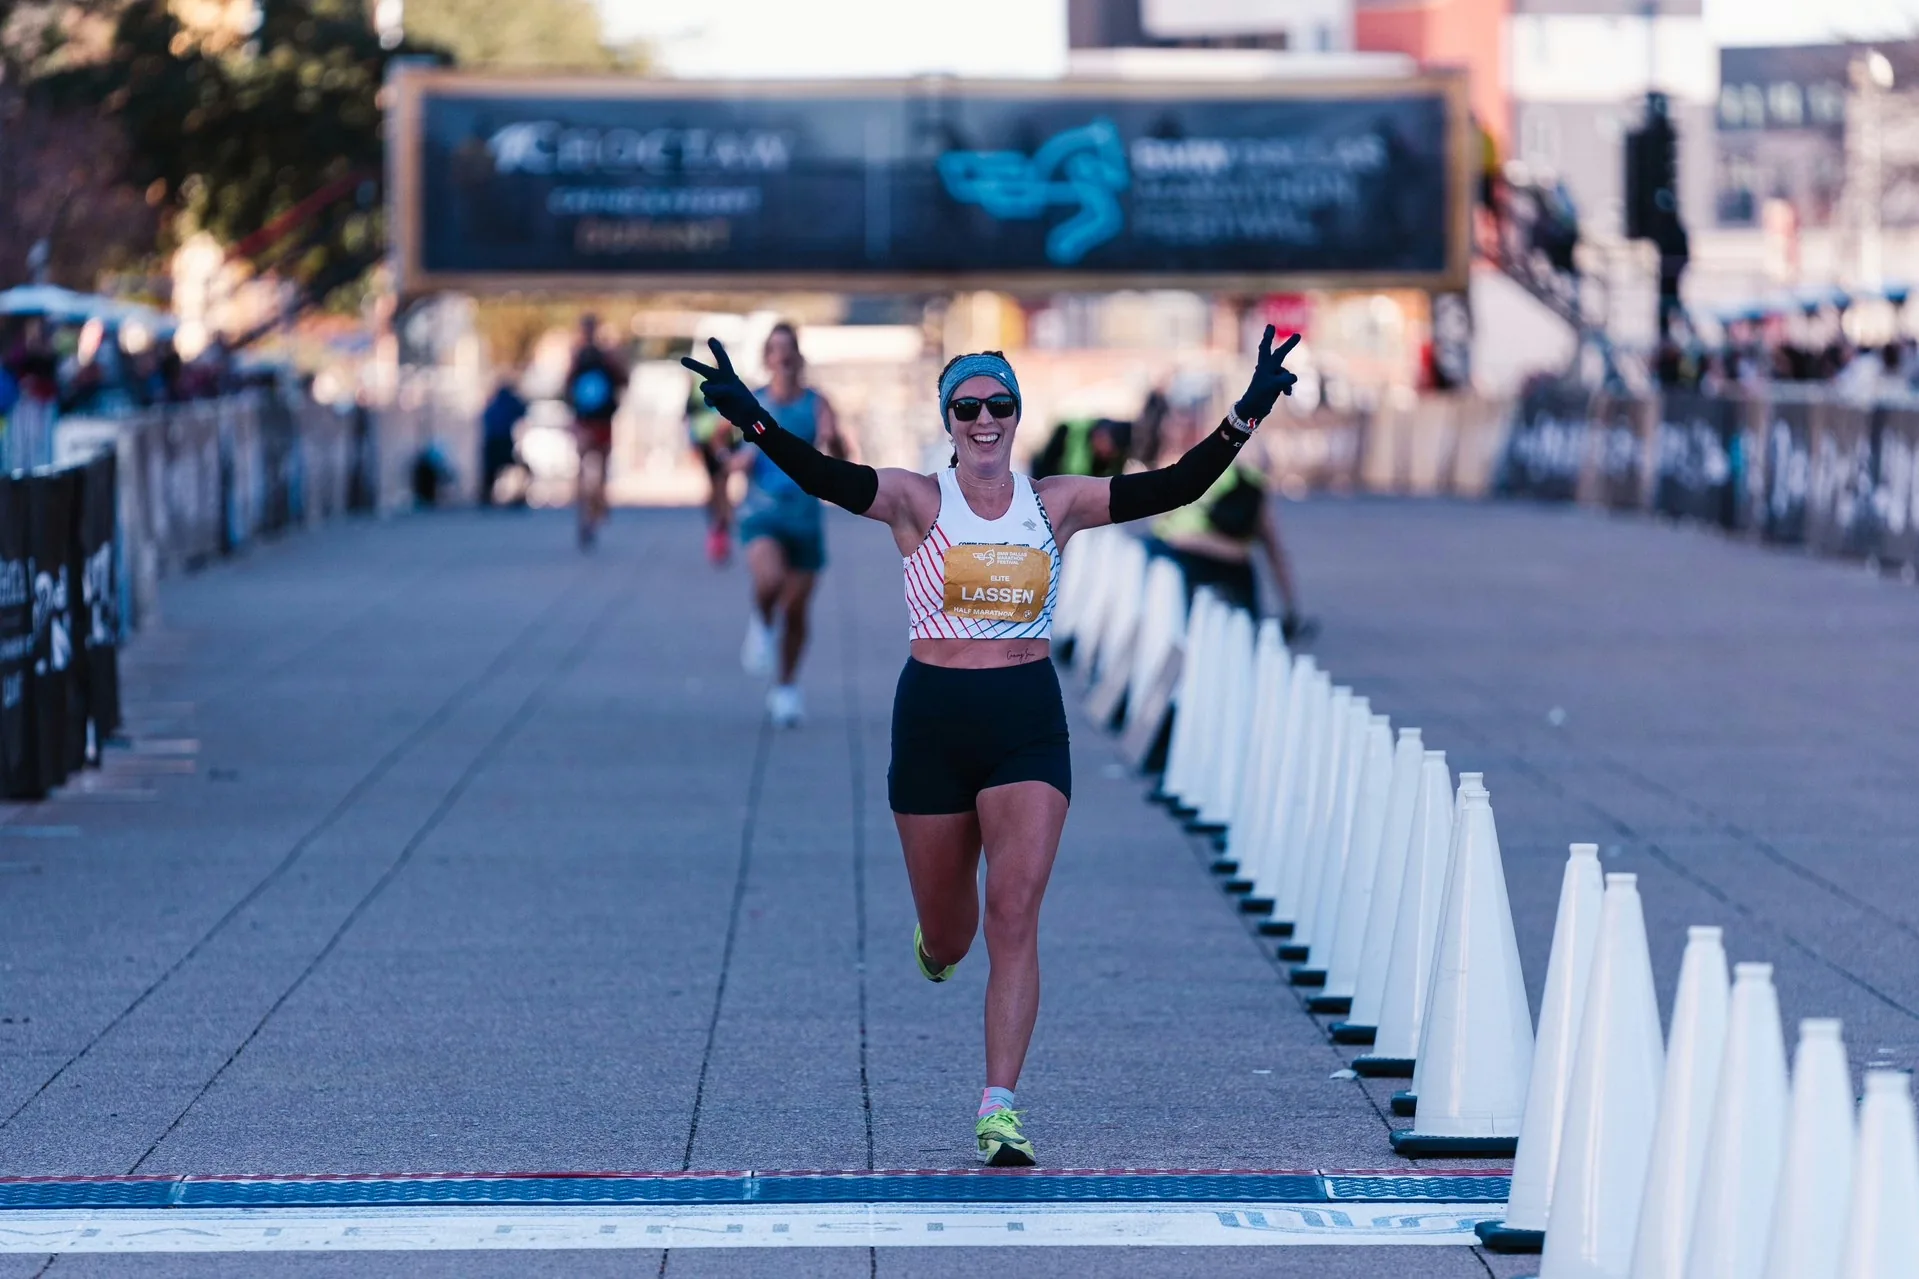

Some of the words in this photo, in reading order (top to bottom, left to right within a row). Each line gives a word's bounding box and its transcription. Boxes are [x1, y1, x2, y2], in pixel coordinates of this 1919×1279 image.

[961, 586, 1034, 604] LASSEN
[953, 606, 972, 614] HALF
[973, 609, 1015, 617] MARATHON
